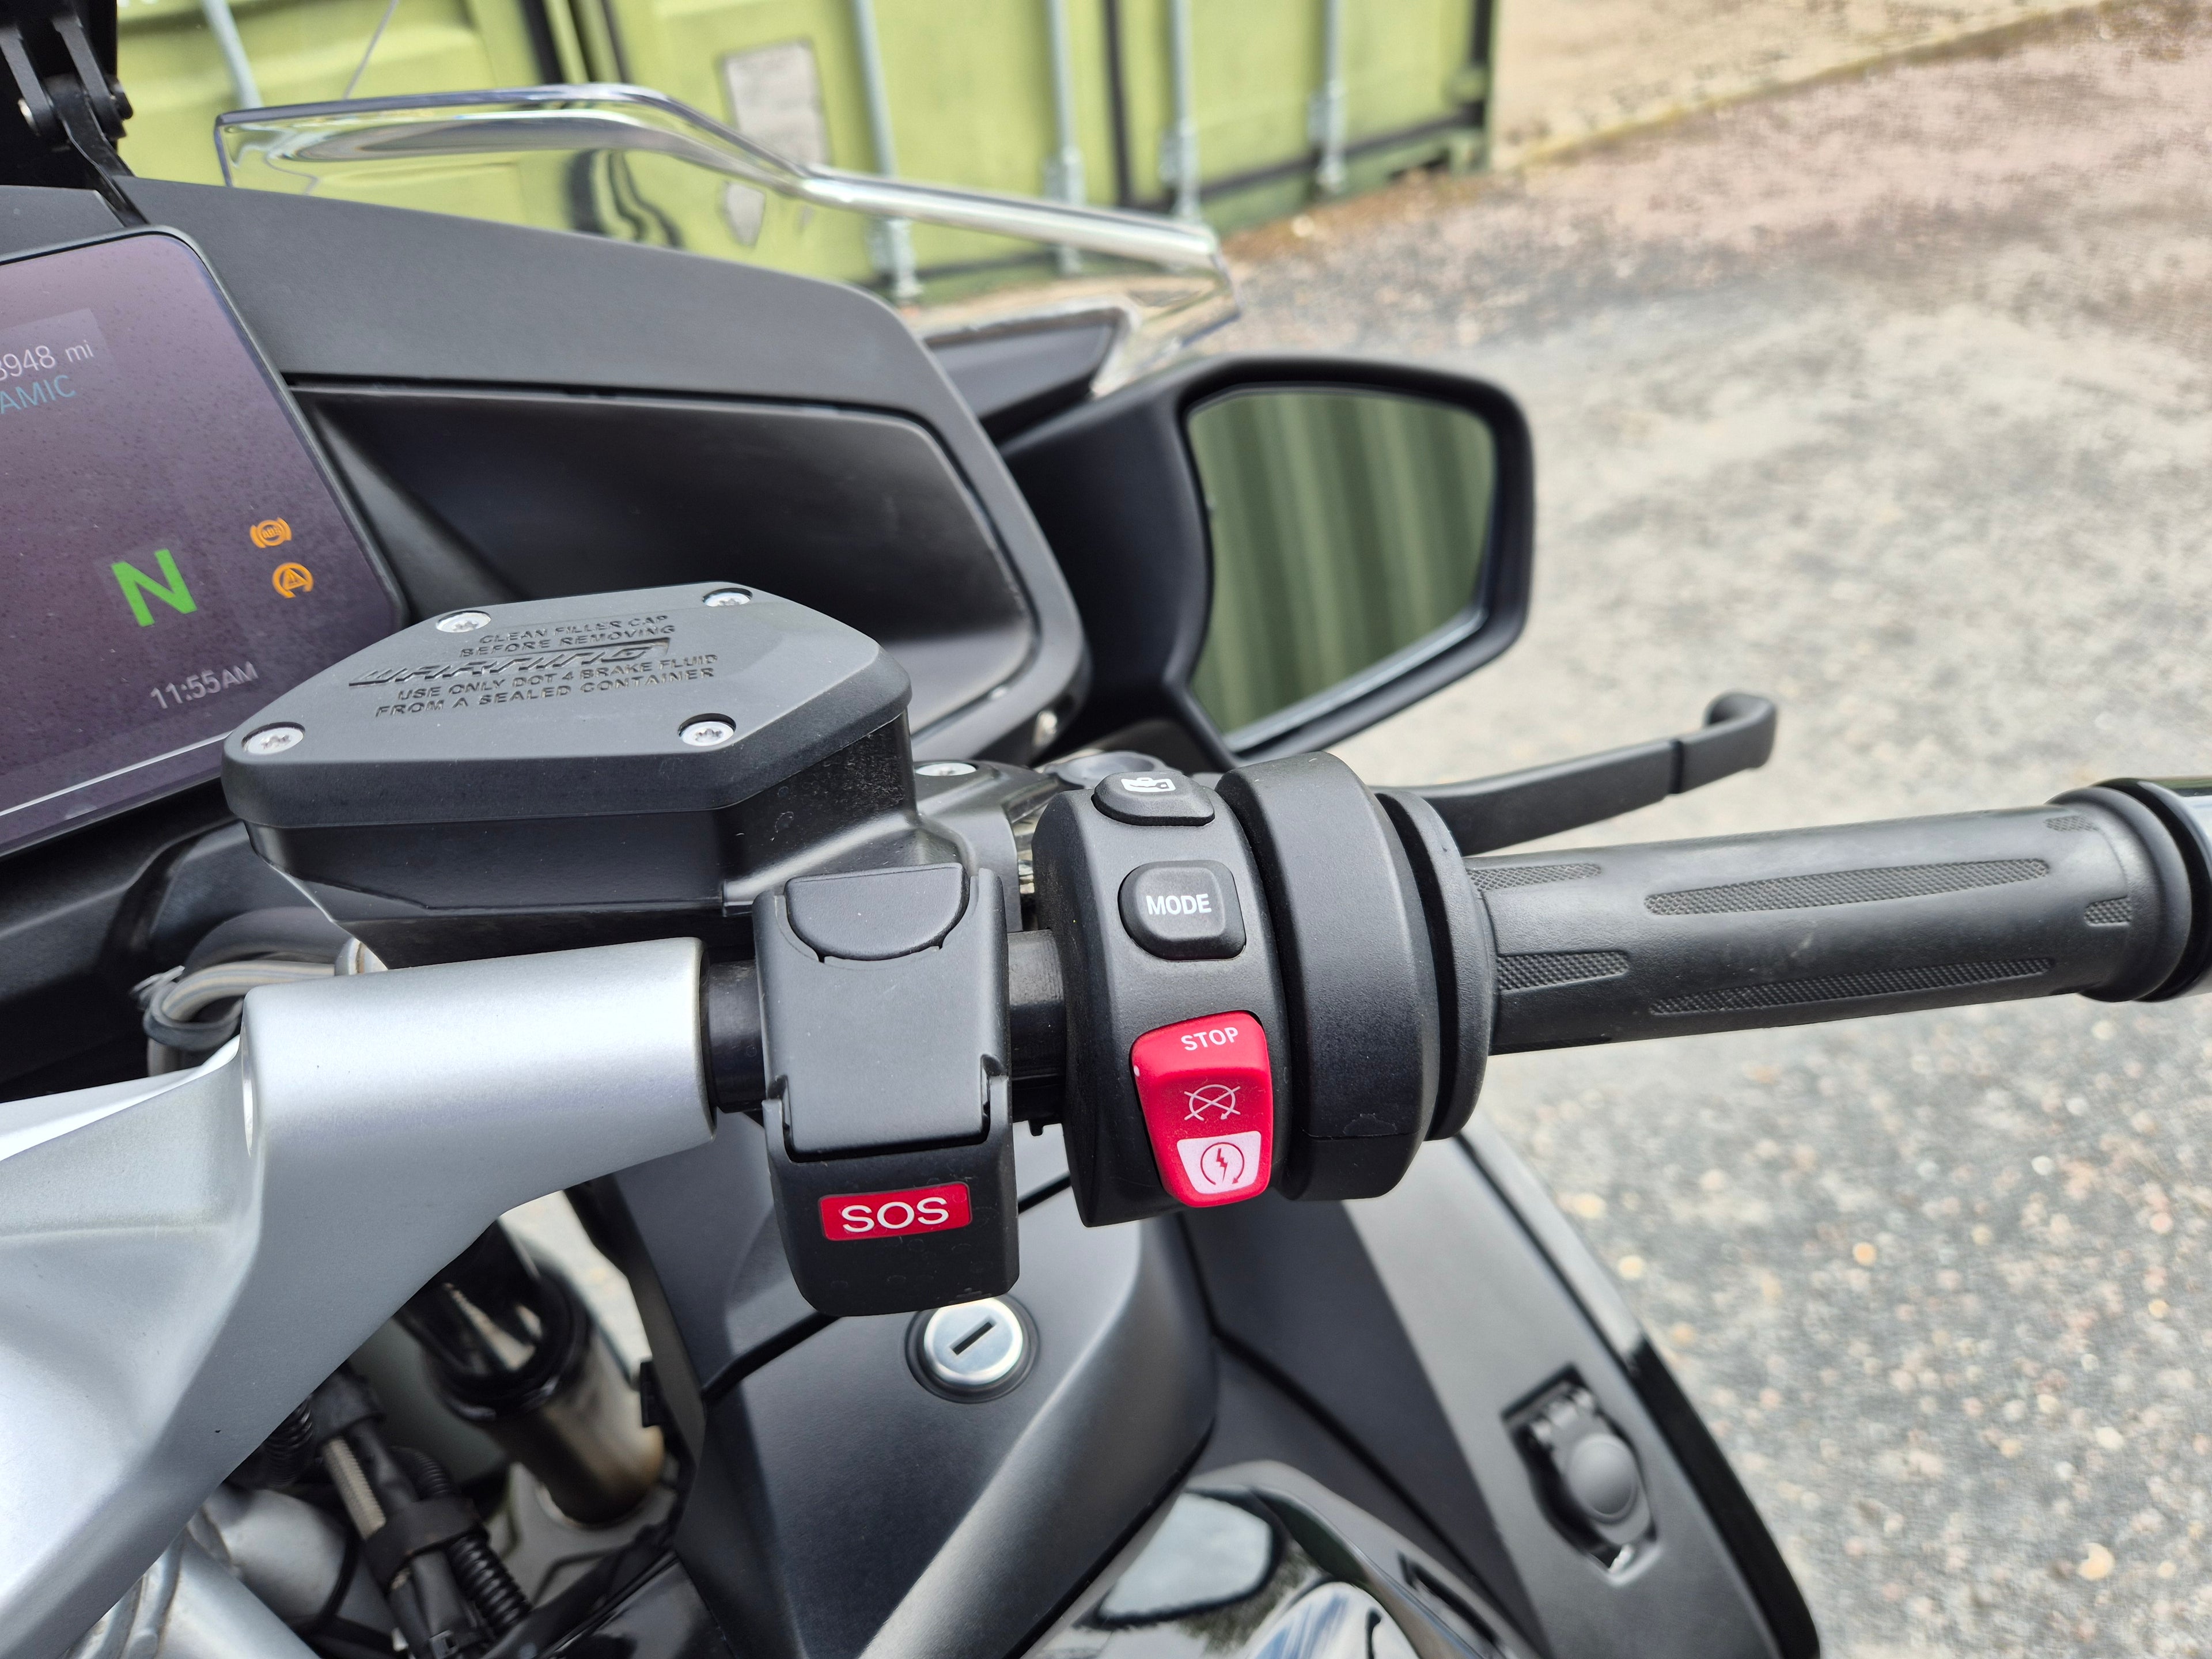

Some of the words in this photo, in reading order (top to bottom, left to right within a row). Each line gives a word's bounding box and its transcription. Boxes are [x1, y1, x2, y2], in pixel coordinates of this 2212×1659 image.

[65, 339, 94, 363] mi
[111, 548, 197, 627] N
[459, 640, 551, 658] BEFORE
[560, 625, 676, 646] REMOVING
[479, 628, 548, 644] CLEAN
[555, 620, 623, 637] FILLER
[627, 615, 669, 627] CAP
[375, 700, 445, 718] FROM
[452, 697, 468, 709] A
[479, 685, 572, 705] SEALED
[579, 667, 715, 693] CONTAINER
[397, 686, 442, 700] USE
[448, 679, 506, 696] ONLY
[512, 673, 558, 688] DOT
[561, 671, 574, 682] 4
[579, 662, 653, 680] BRAKE
[658, 654, 718, 671] FLUID
[1146, 893, 1212, 915] MODE
[1180, 1027, 1238, 1051] STOP
[841, 1196, 949, 1233] SOS
